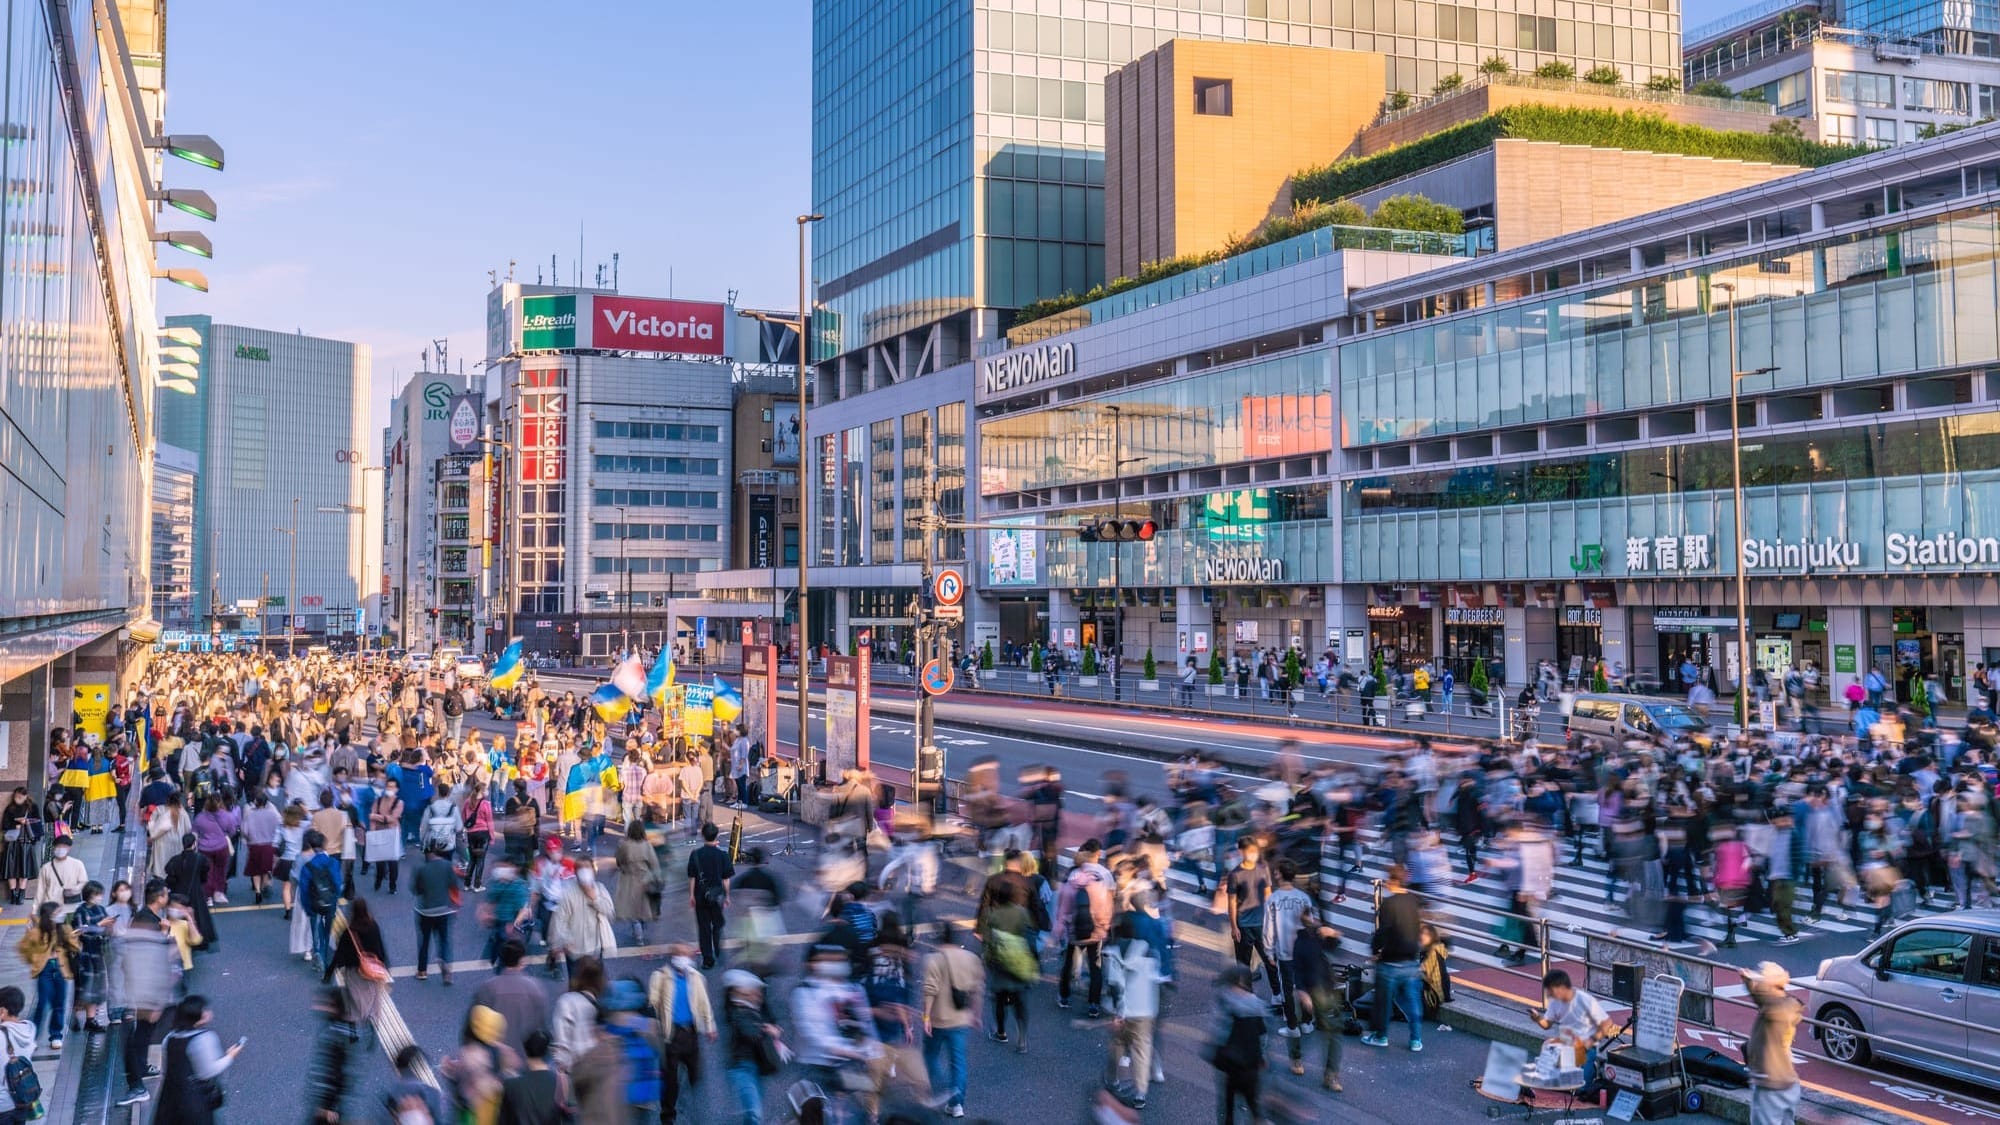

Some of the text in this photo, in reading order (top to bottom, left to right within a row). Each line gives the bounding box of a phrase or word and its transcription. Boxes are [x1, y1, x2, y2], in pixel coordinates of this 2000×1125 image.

[602, 309, 713, 341] Victoria
[545, 396, 561, 477] Victoria
[1569, 543, 1604, 572] JR
[1626, 534, 1710, 571] 新宿駅
[1743, 531, 2000, 575] Shinjuku Station
[1462, 608, 1494, 622] DEGREES
[1584, 610, 1601, 623] DEG
